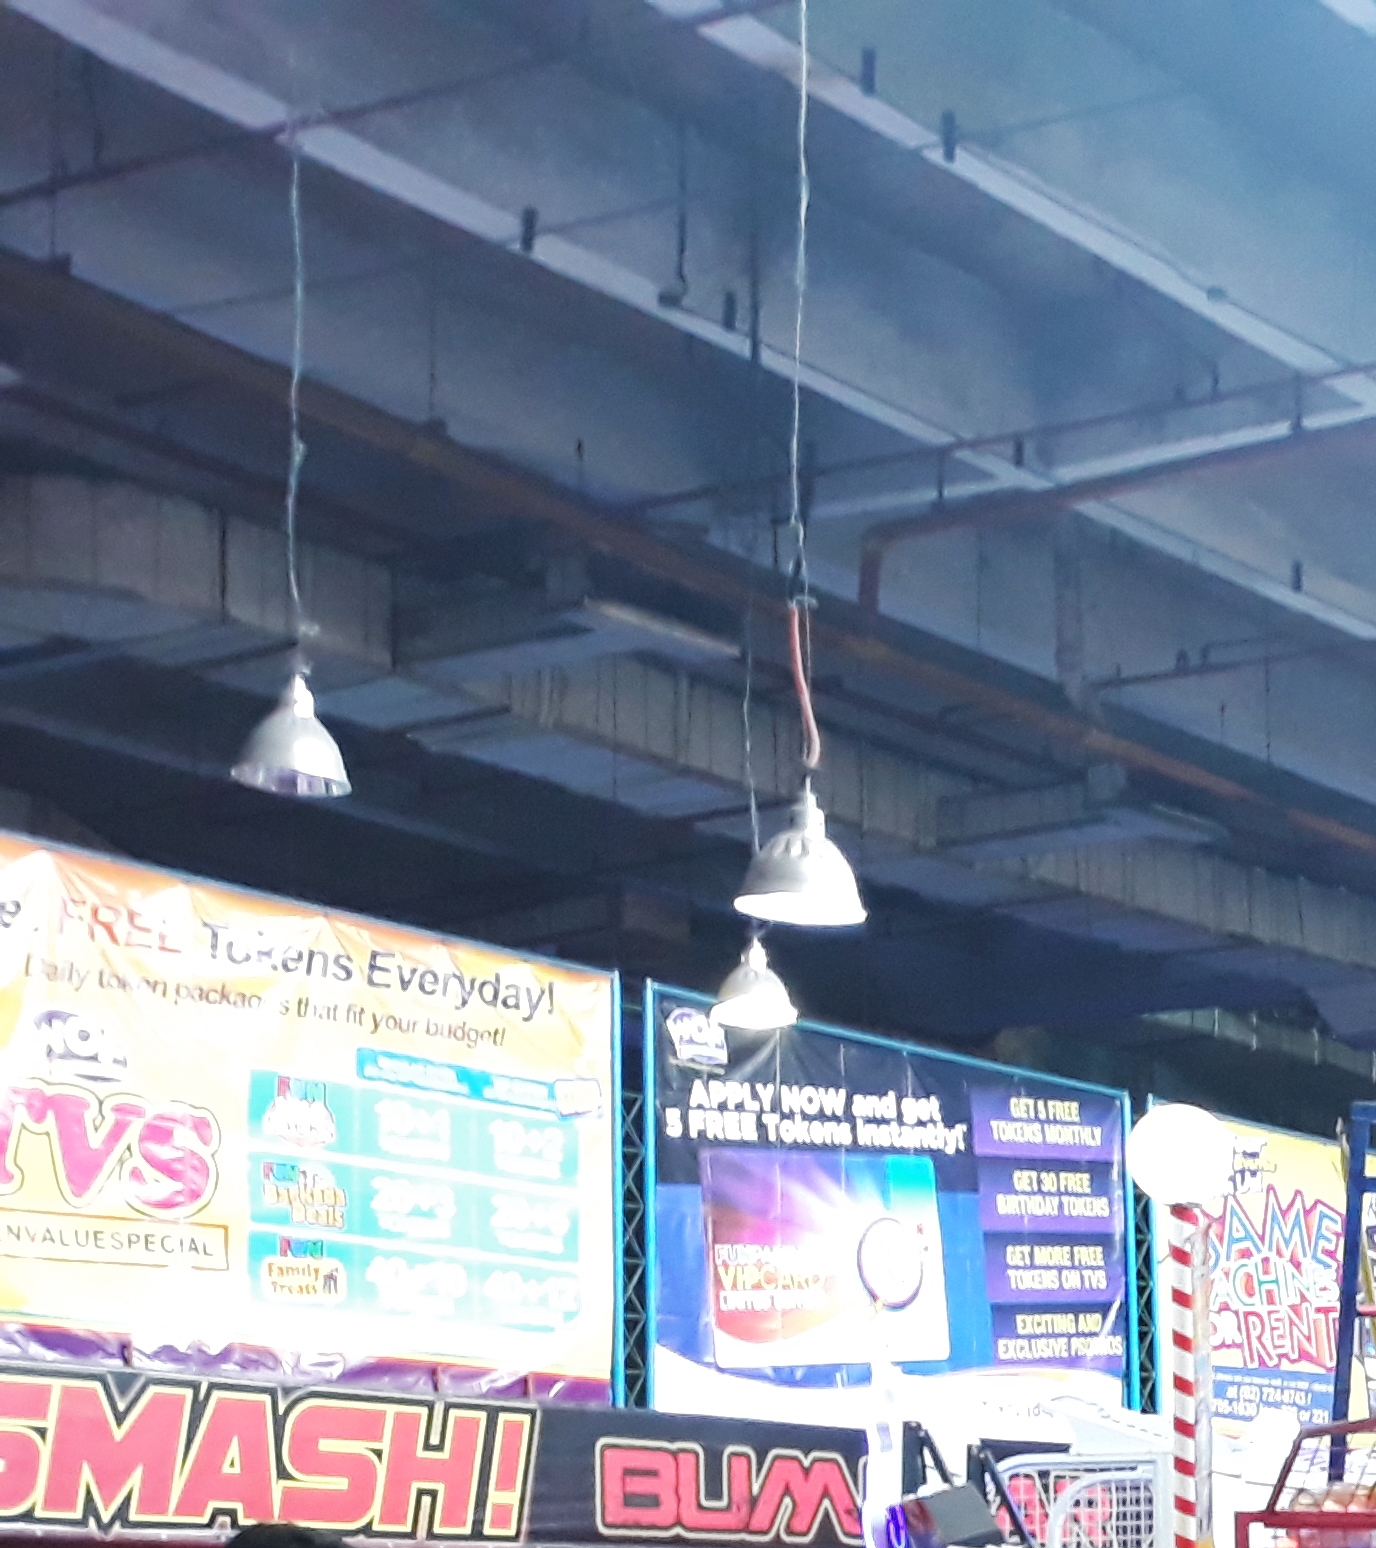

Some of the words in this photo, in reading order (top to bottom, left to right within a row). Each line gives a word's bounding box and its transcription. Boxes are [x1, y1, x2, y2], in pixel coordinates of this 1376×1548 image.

[366, 950, 556, 1023] Everyday!
[174, 983, 291, 1017] packas
[370, 1011, 420, 1036] your
[689, 1079, 774, 1112] APPLY
[780, 1084, 847, 1117] NOW
[851, 1090, 897, 1119] and
[901, 1095, 942, 1125] get
[1010, 1097, 1036, 1119] GET
[1047, 1099, 1081, 1123] FREE
[664, 1106, 683, 1139] 5
[688, 1109, 759, 1142] FREE
[762, 1113, 852, 1146] Tokens
[990, 1119, 1043, 1145] TOKENS
[1013, 1169, 1038, 1192] GET
[1059, 1172, 1092, 1194] FREE
[1061, 1196, 1110, 1218] TOKENS
[1208, 1191, 1342, 1270] AME
[1006, 1245, 1031, 1267] GET
[1033, 1245, 1072, 1267] MORE
[1073, 1245, 1106, 1267] FREE
[267, 1261, 321, 1284] Family
[1007, 1269, 1060, 1290] TOKENS
[1061, 1269, 1082, 1290] ON
[1210, 1253, 1341, 1307] ACHINES
[1015, 1313, 1077, 1335] EXCITING
[1208, 1309, 1243, 1347] OR
[1242, 1303, 1340, 1370] RENT
[997, 1337, 1069, 1360] EXCLUSIVE
